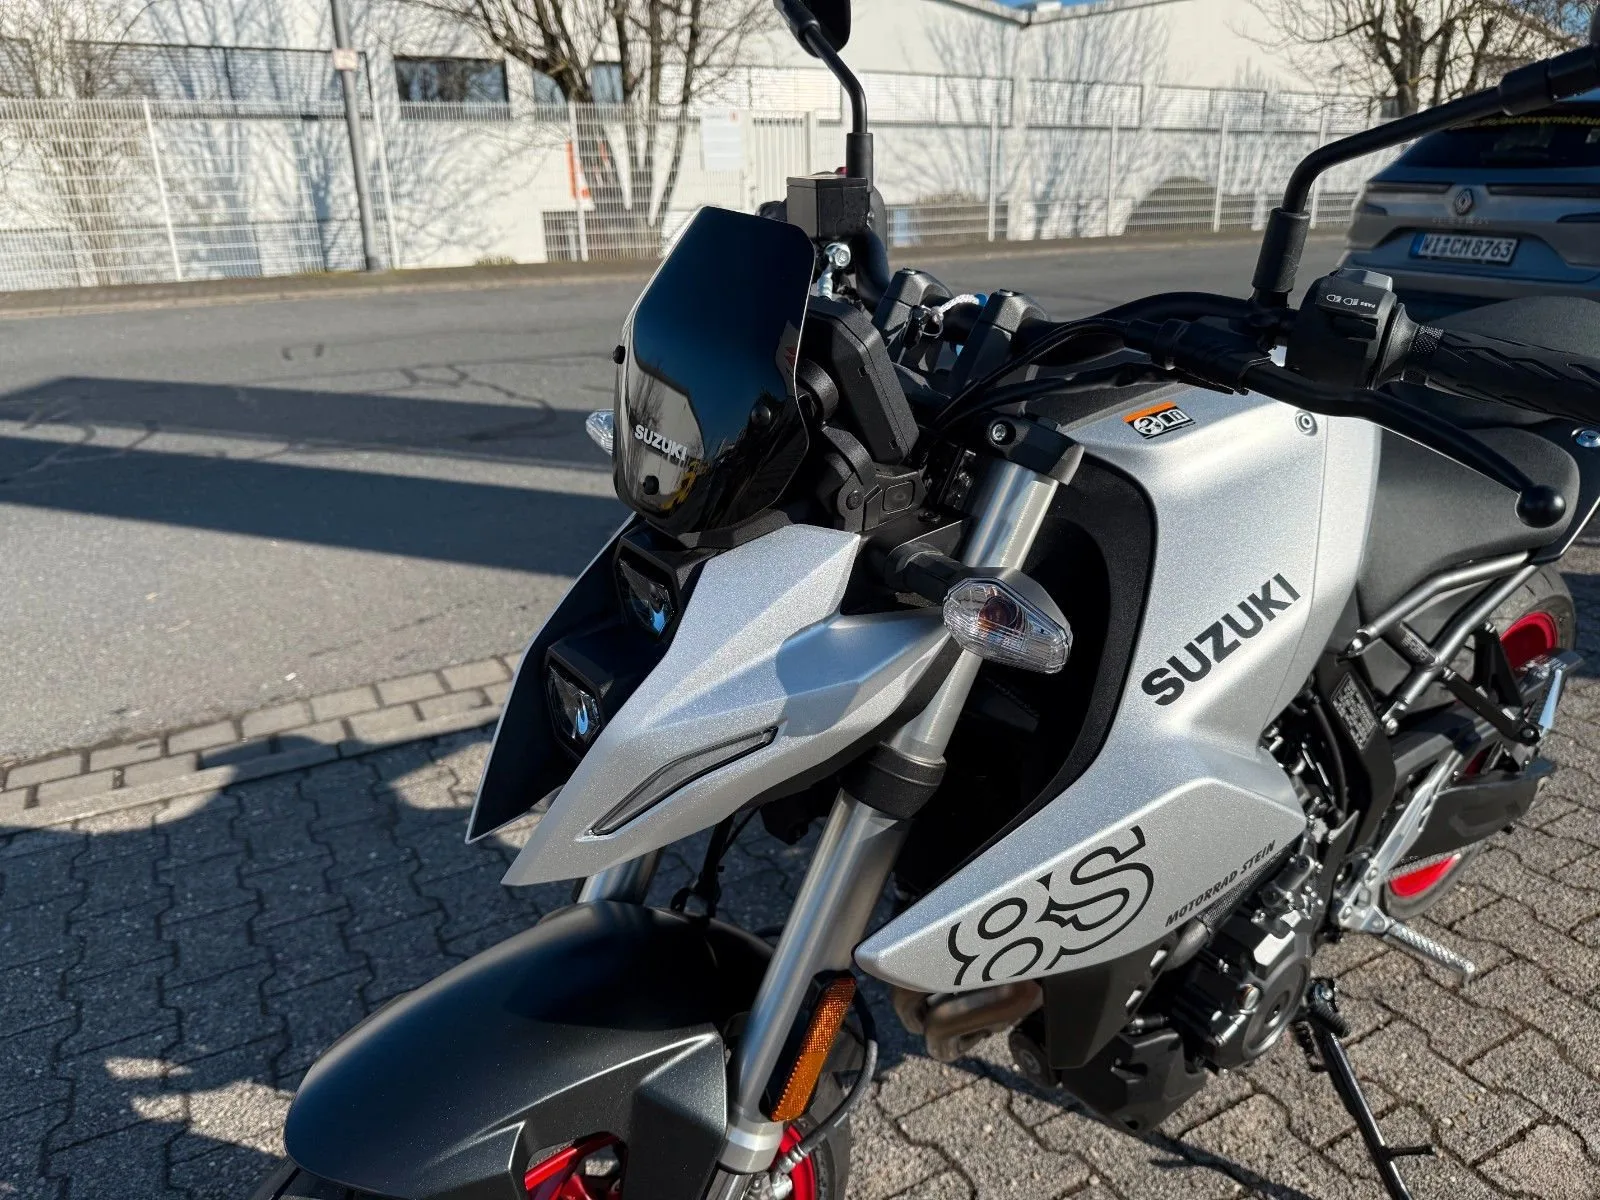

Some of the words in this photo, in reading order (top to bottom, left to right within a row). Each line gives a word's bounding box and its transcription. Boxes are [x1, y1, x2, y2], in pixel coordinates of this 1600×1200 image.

[634, 424, 688, 460] SUZUKI
[1141, 573, 1301, 706] SUZUKI
[1165, 870, 1238, 927] MOTORRAD
[1240, 840, 1275, 874] STEIN
